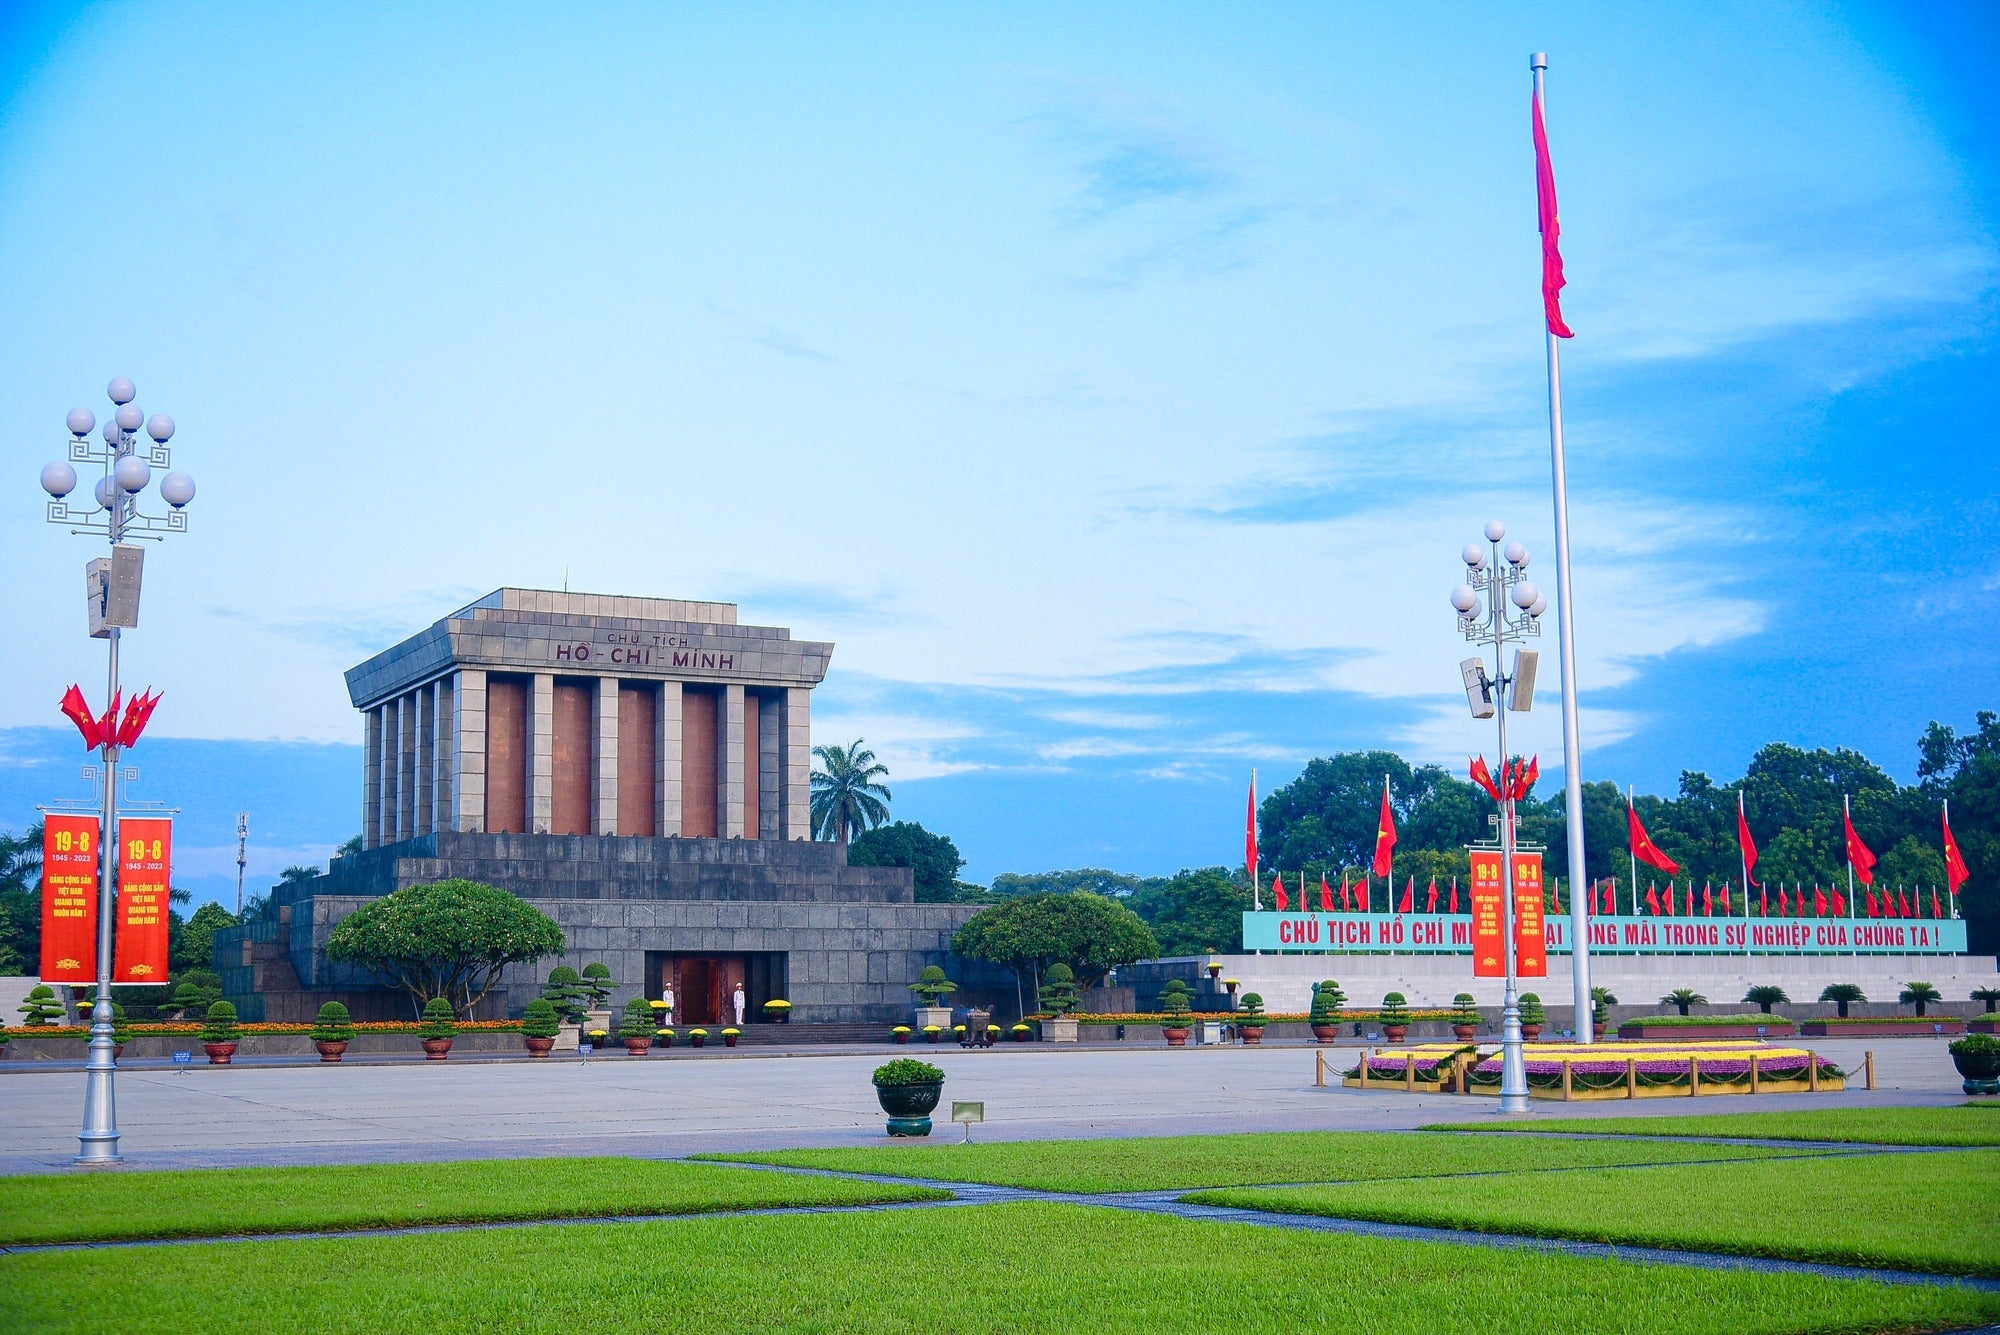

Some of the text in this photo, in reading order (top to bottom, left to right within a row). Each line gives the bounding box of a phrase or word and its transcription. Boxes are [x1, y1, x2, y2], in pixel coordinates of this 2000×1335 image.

[653, 633, 688, 649] TỊCH
[54, 831, 90, 852] 19-8
[127, 840, 162, 860] 19-8
[52, 854, 68, 862] 1945
[73, 854, 91, 862] 2023
[125, 862, 141, 870] 1945
[147, 862, 163, 870] 2023
[1279, 913, 1319, 944] CHỦ
[1327, 920, 1370, 948] TỊCH
[1379, 914, 1404, 944] HỒ
[1412, 917, 1443, 944] CHÍ
[1452, 921, 1473, 944] MI
[1546, 923, 1563, 949] ẠI
[1625, 920, 1657, 945] MÃI
[1663, 923, 1719, 946] TRONG
[1725, 922, 1747, 949] SỰ
[1753, 921, 1811, 949] NGHIỆP
[1816, 918, 1847, 946] CỦA
[1853, 921, 1904, 946] CHÚNG
[1909, 925, 1929, 946] TA
[1935, 926, 1940, 946] !
